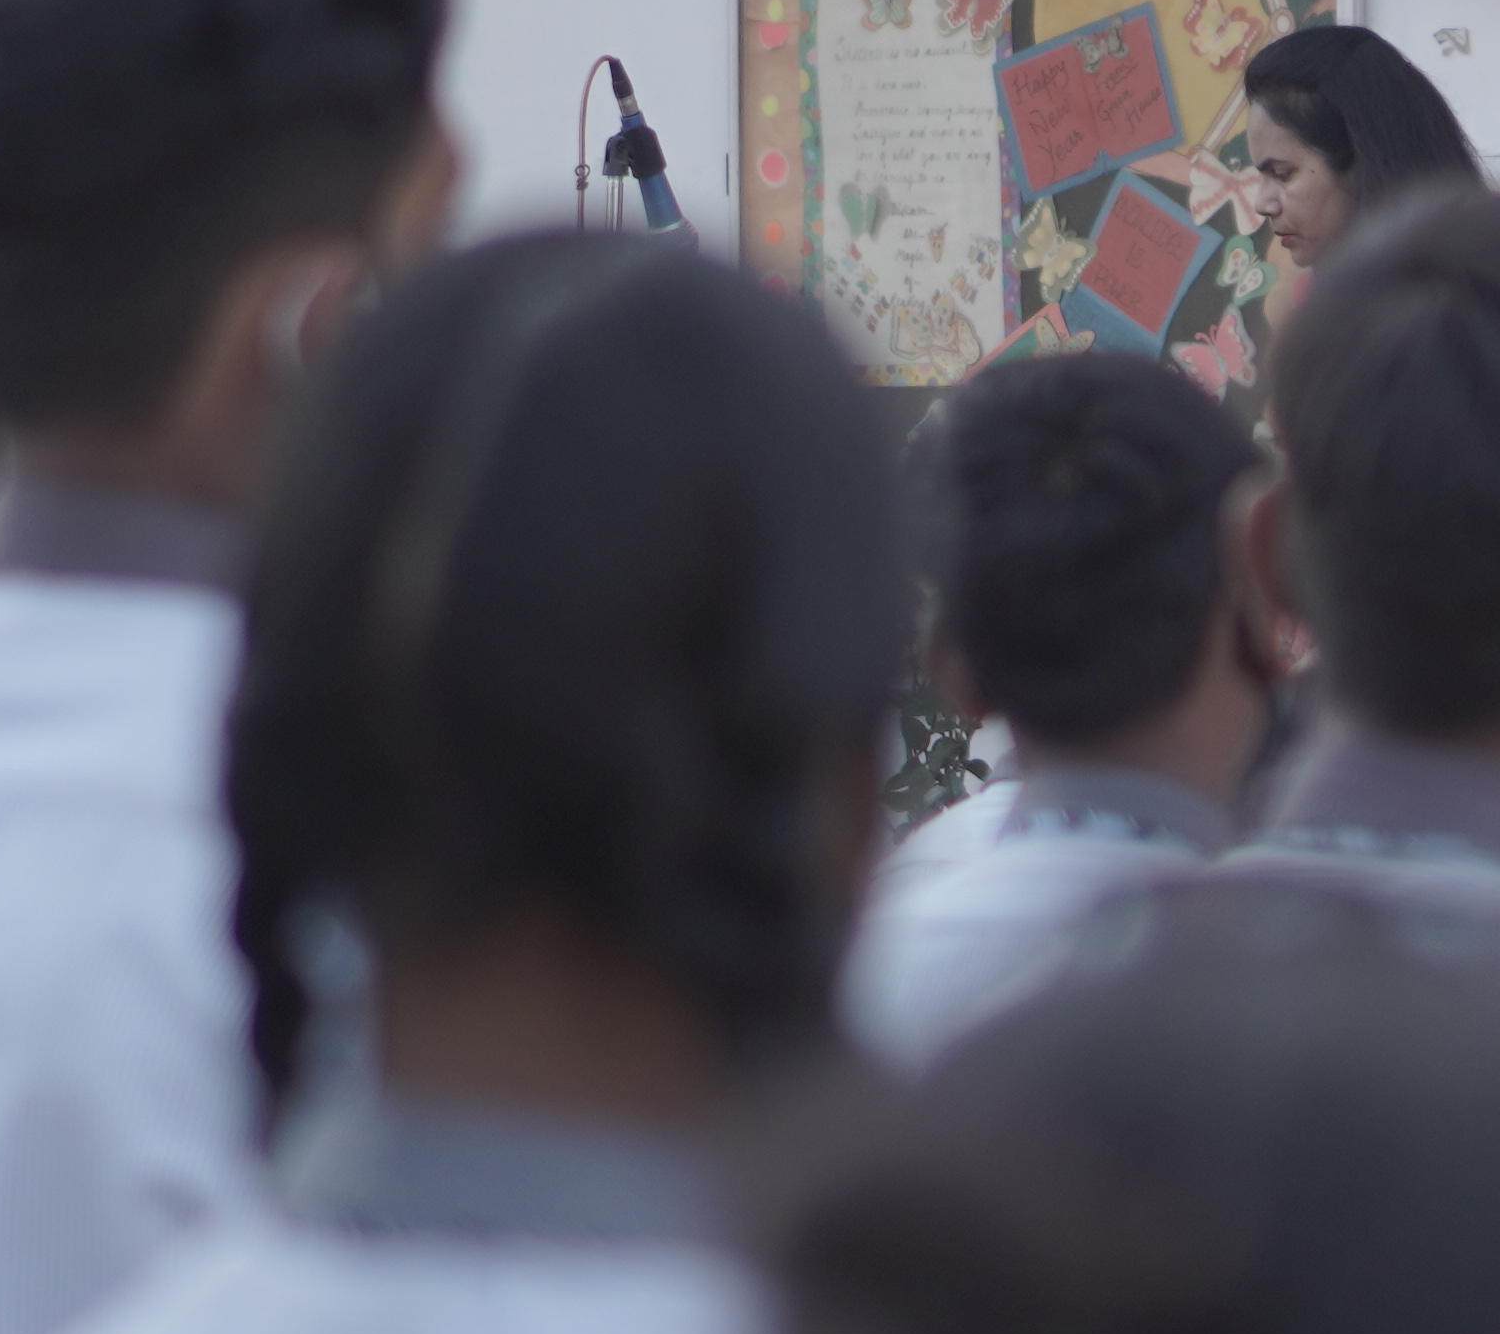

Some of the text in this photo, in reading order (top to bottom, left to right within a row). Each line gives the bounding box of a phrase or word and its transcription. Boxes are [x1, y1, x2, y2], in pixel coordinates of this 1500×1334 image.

[1012, 61, 1069, 105] Happy
[1028, 99, 1071, 135] New
[1037, 130, 1084, 179] Year
